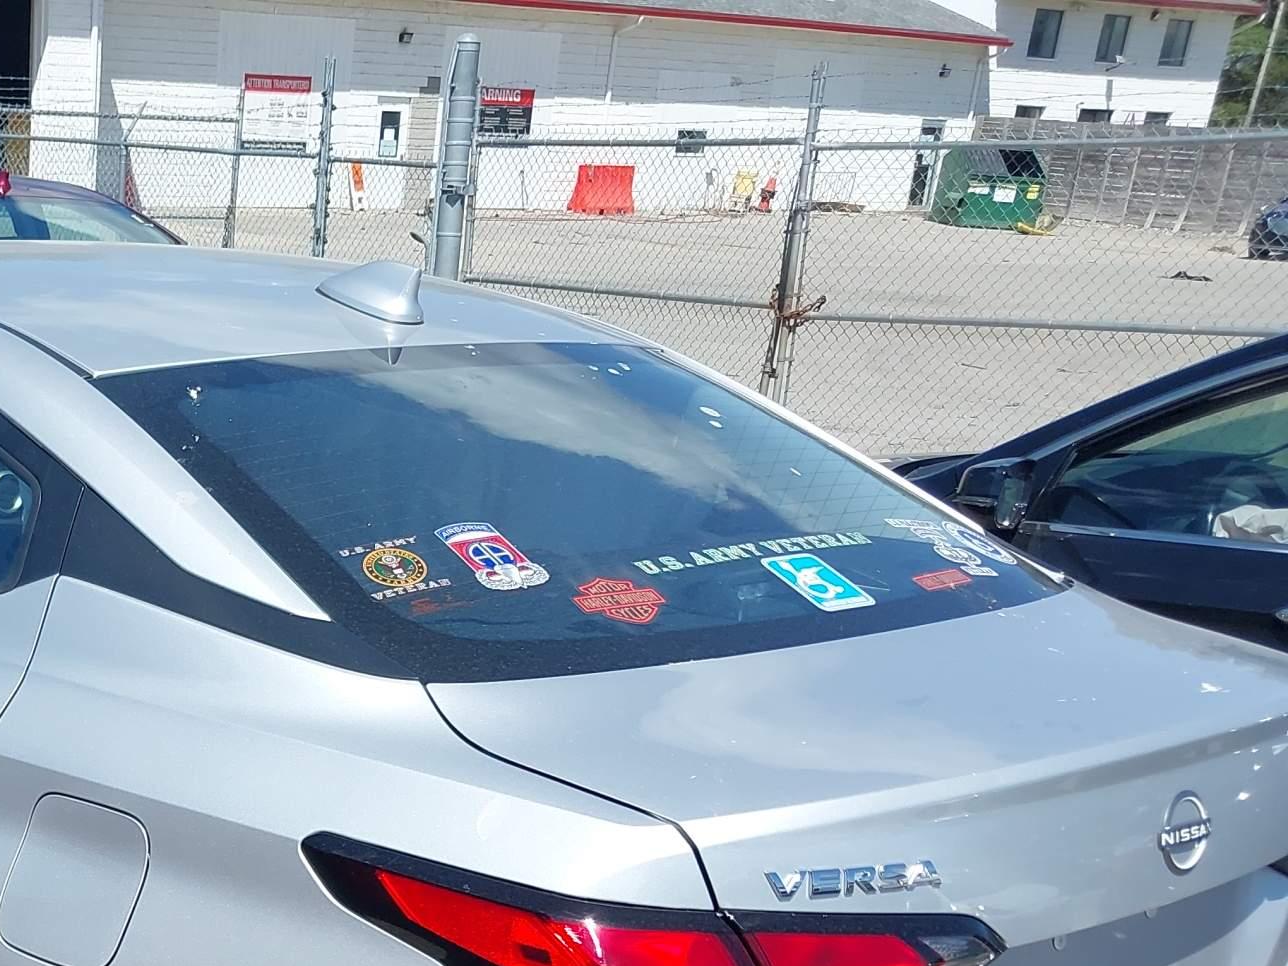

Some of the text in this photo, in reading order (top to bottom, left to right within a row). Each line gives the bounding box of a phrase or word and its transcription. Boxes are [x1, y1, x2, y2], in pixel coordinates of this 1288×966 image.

[481, 88, 521, 103] ARNING
[441, 524, 489, 538] AIRBORNE
[373, 535, 417, 551] ARMY
[632, 531, 873, 576] U.S. ARMY VETERAN
[370, 578, 453, 601] VETERAN
[588, 581, 631, 596] MOTOR
[580, 591, 659, 610] HARLEY-DAVIDSON
[610, 604, 653, 620] CYCLES
[763, 859, 943, 902] VERSA
